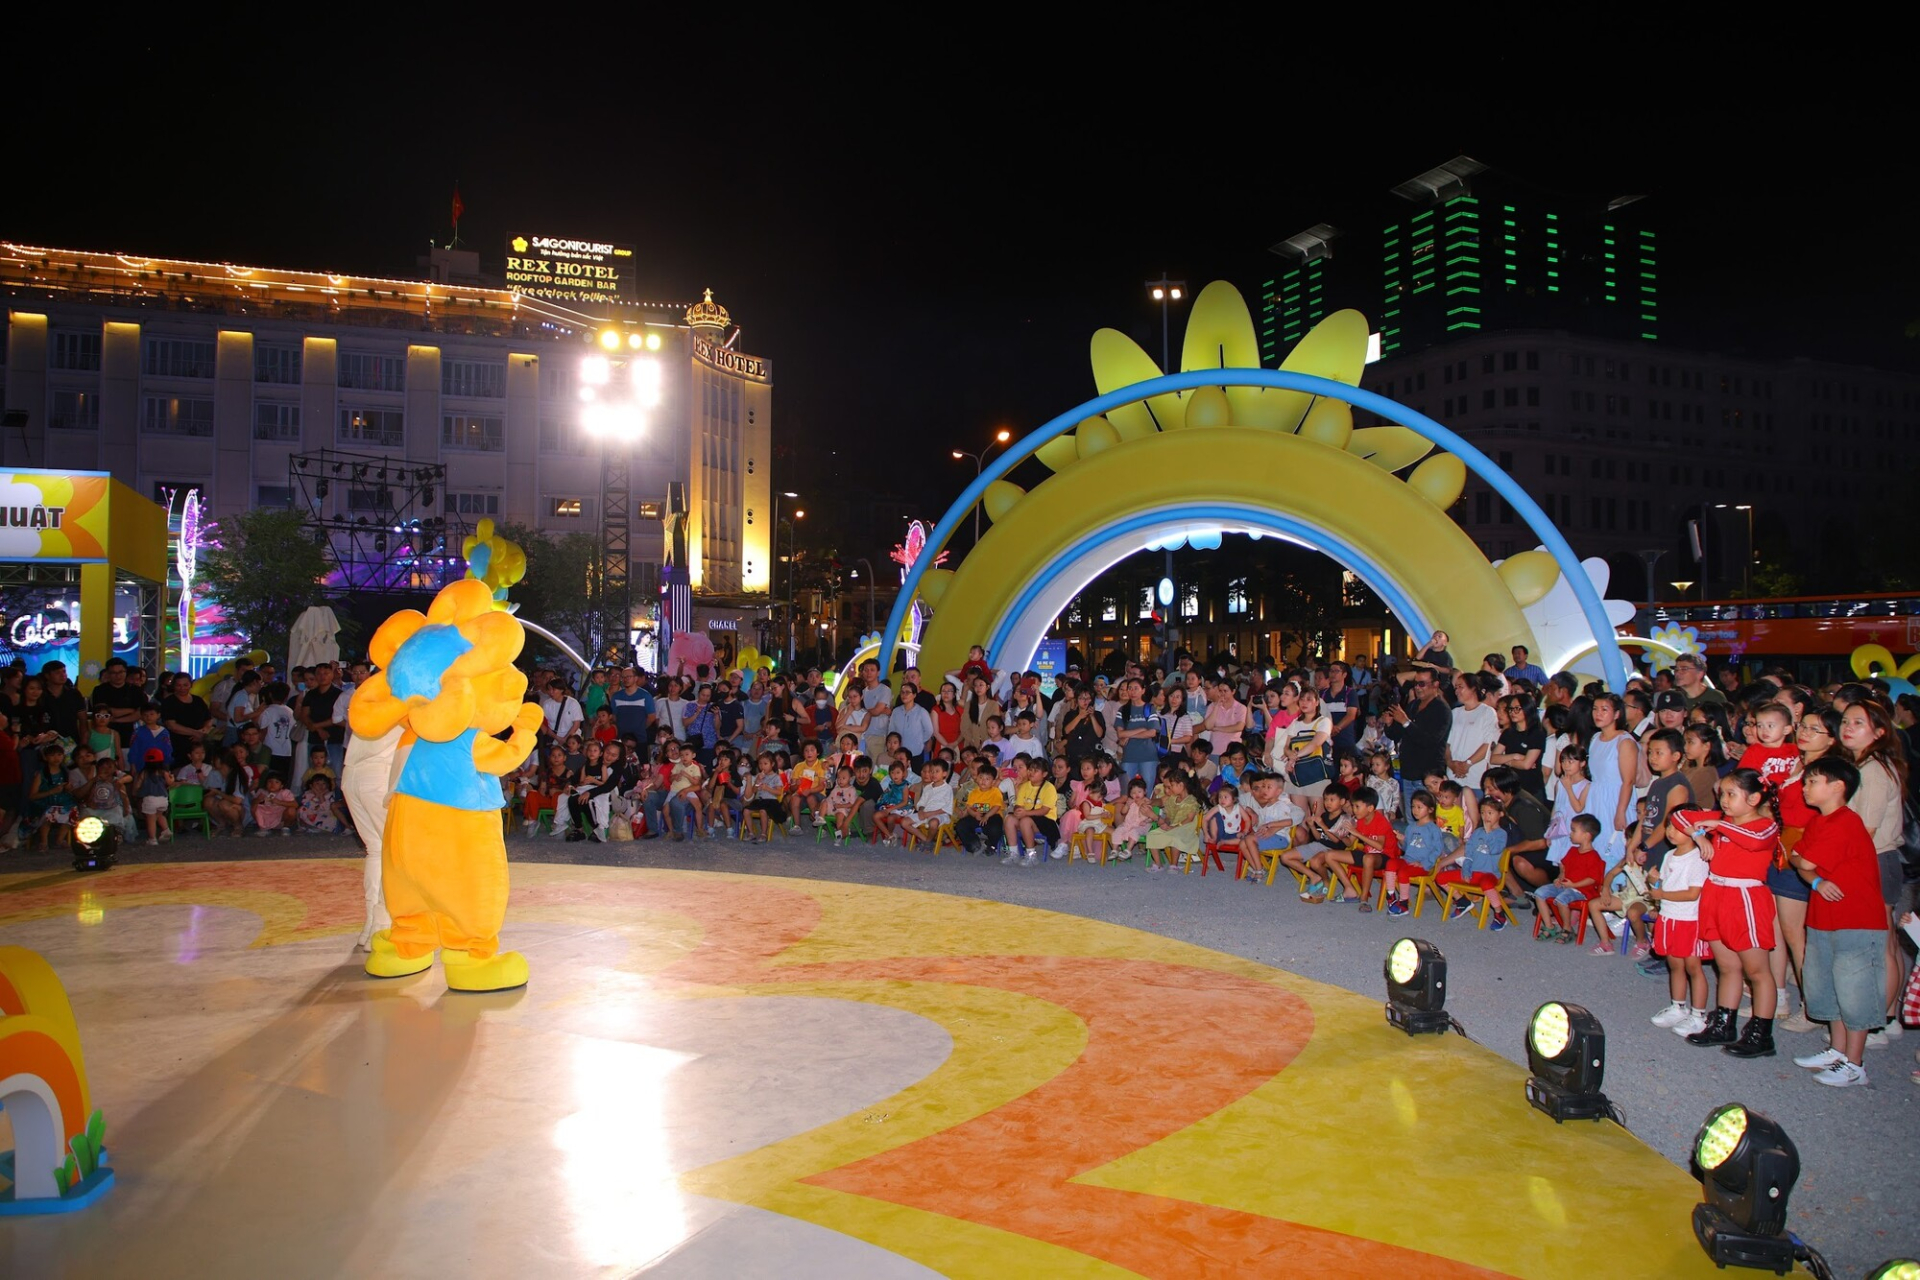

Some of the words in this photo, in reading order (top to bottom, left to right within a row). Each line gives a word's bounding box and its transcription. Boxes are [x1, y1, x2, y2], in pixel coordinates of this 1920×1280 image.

[532, 236, 613, 255] SAIGONTOURIST
[506, 257, 550, 273] REX
[555, 261, 619, 280] HOTEL
[506, 272, 552, 283] ROOFTOP
[554, 276, 593, 288] GARDEN
[596, 280, 616, 290] BAR
[716, 348, 766, 377] HOTEL
[709, 619, 738, 631] CHANEL
